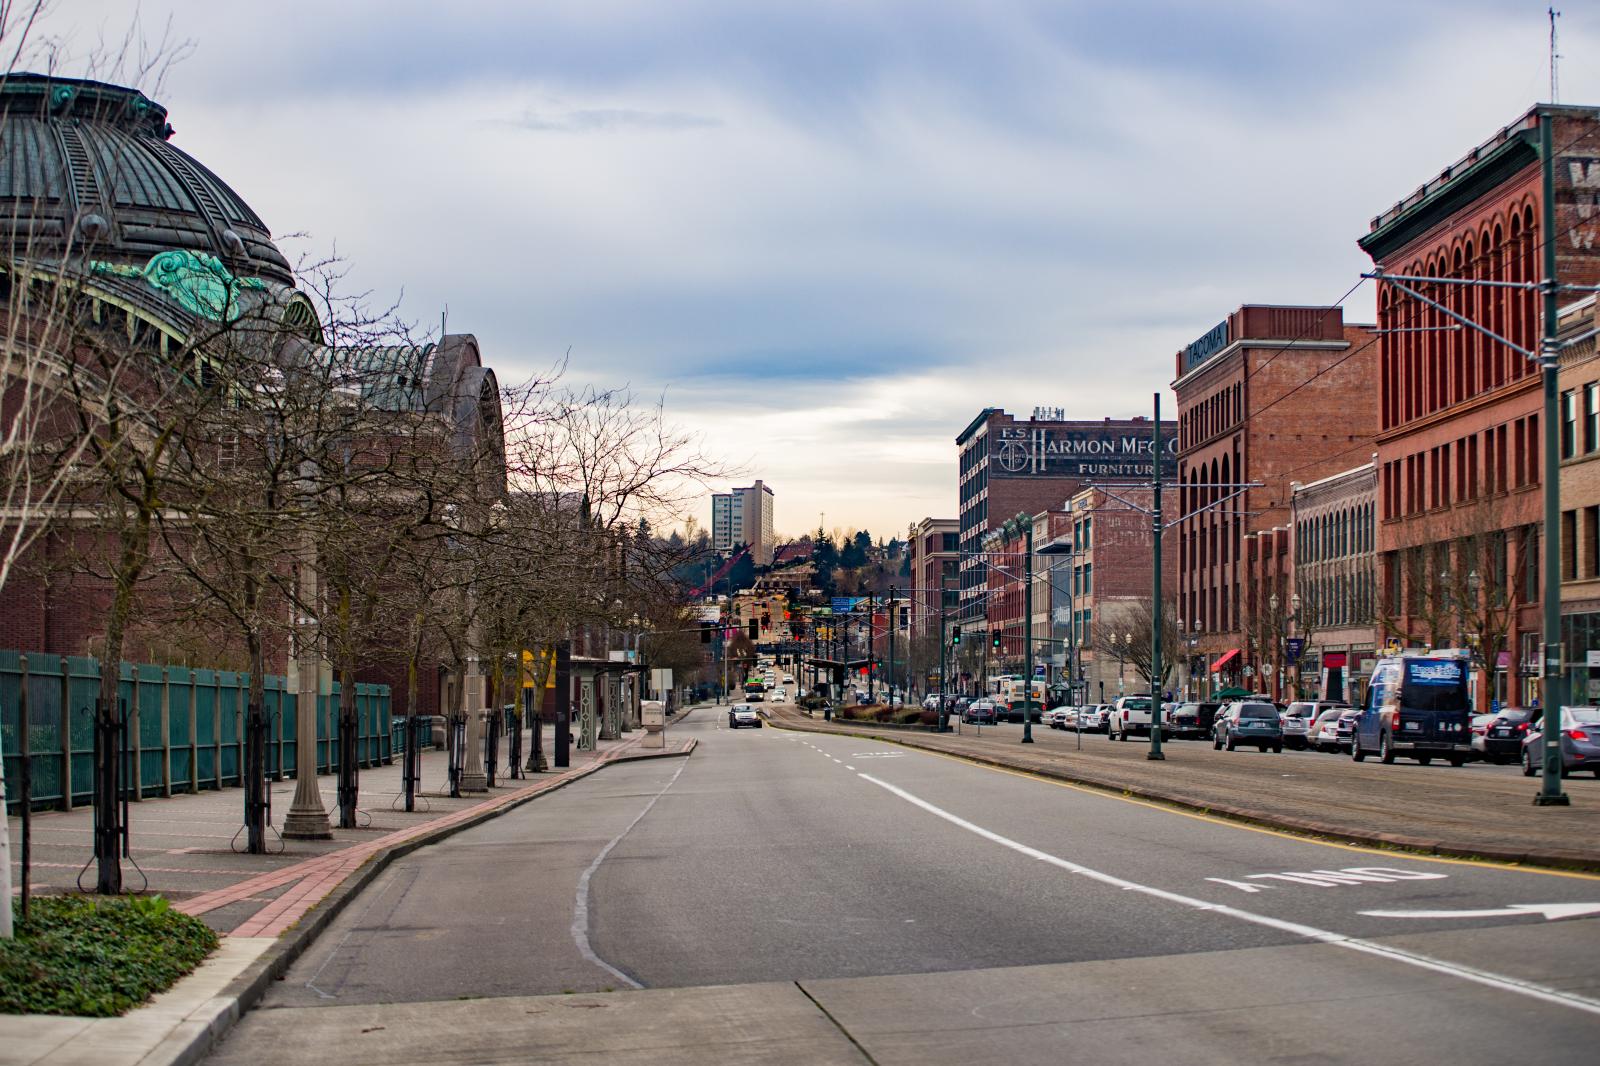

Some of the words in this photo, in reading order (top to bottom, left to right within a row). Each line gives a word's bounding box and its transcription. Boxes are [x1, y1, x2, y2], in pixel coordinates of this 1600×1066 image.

[1188, 326, 1223, 365] TACOMA
[1031, 428, 1115, 474] HARMON
[1204, 867, 1449, 893] ONLY
